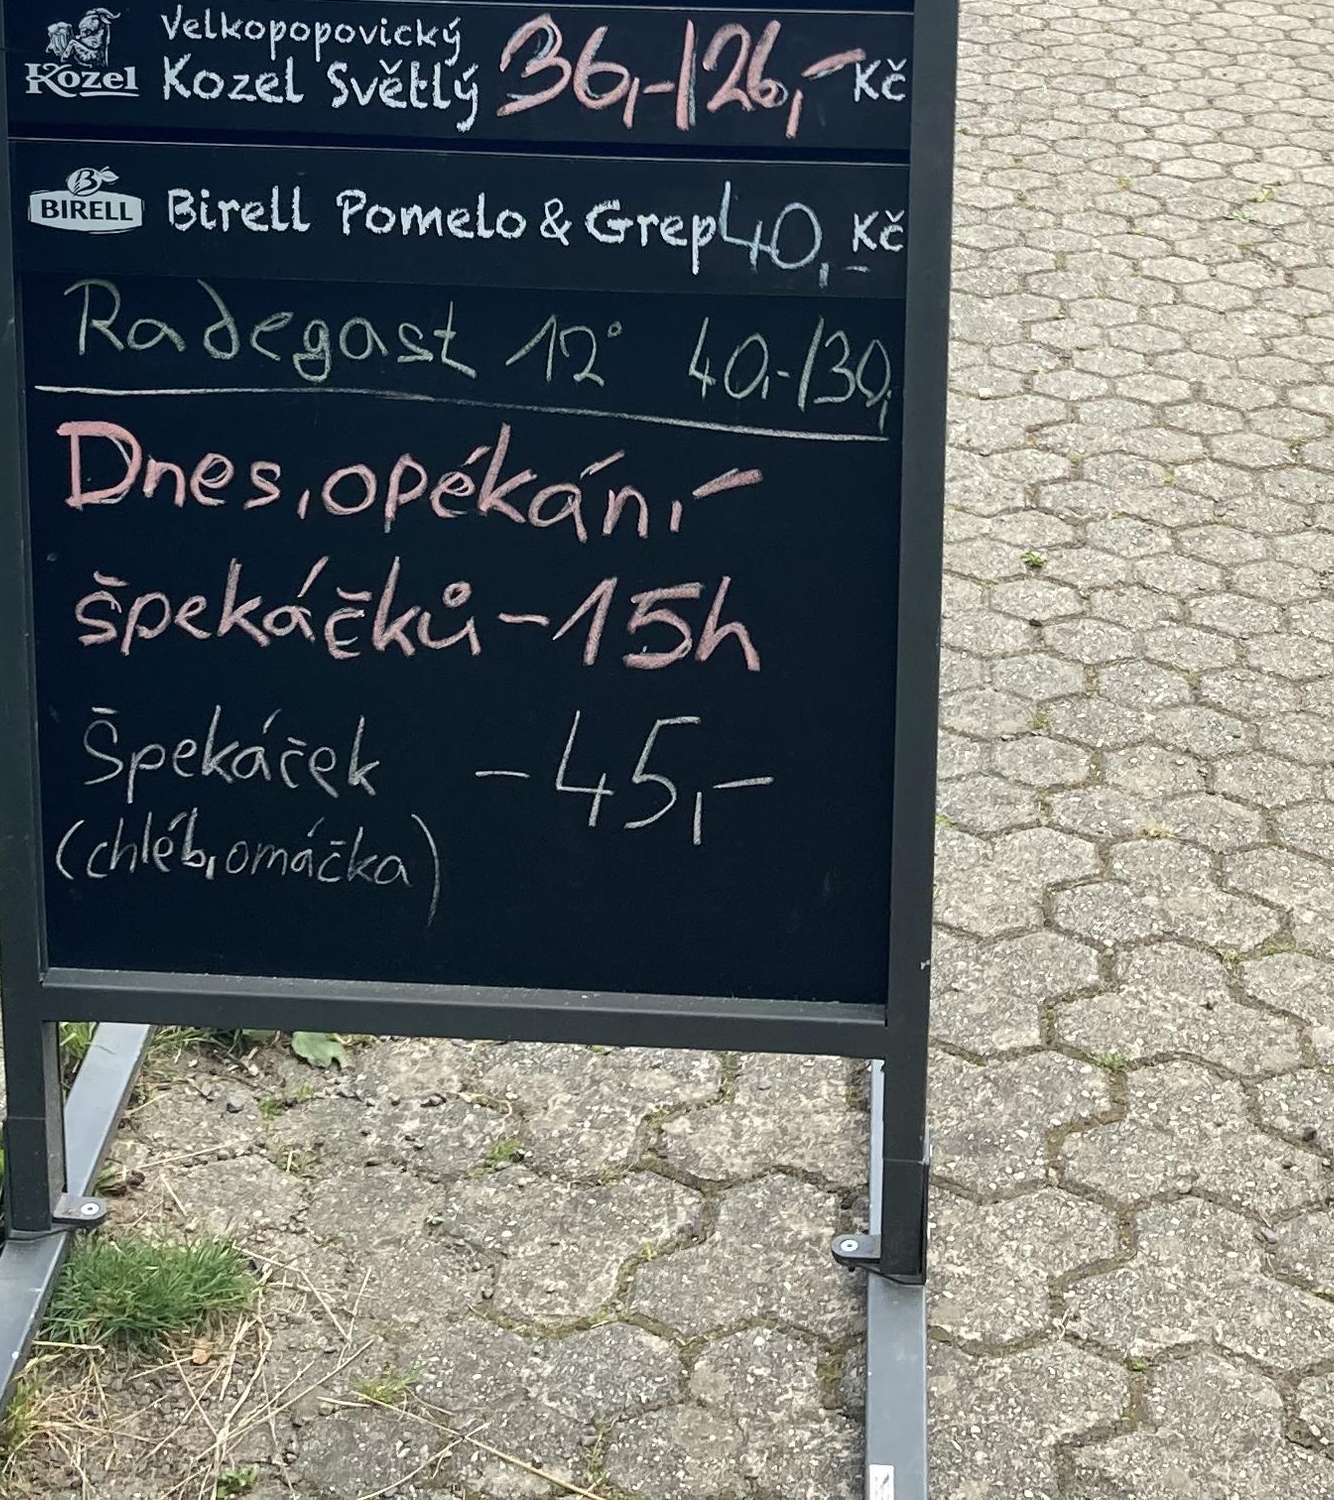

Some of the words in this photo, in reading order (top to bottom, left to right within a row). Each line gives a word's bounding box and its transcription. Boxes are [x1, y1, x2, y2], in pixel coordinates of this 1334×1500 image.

[162, 7, 464, 67] Velkopopovický
[25, 59, 140, 99] Kozel
[163, 60, 305, 102] Kozel
[329, 58, 479, 133] Světlý
[854, 49, 907, 102] Kč
[41, 197, 133, 225] BIRELL
[168, 188, 311, 234] Birell
[338, 193, 526, 240] Pomelo
[540, 199, 572, 239] &
[586, 201, 715, 275] Grep
[852, 210, 906, 253] Kč
[64, 279, 477, 382] Radegast
